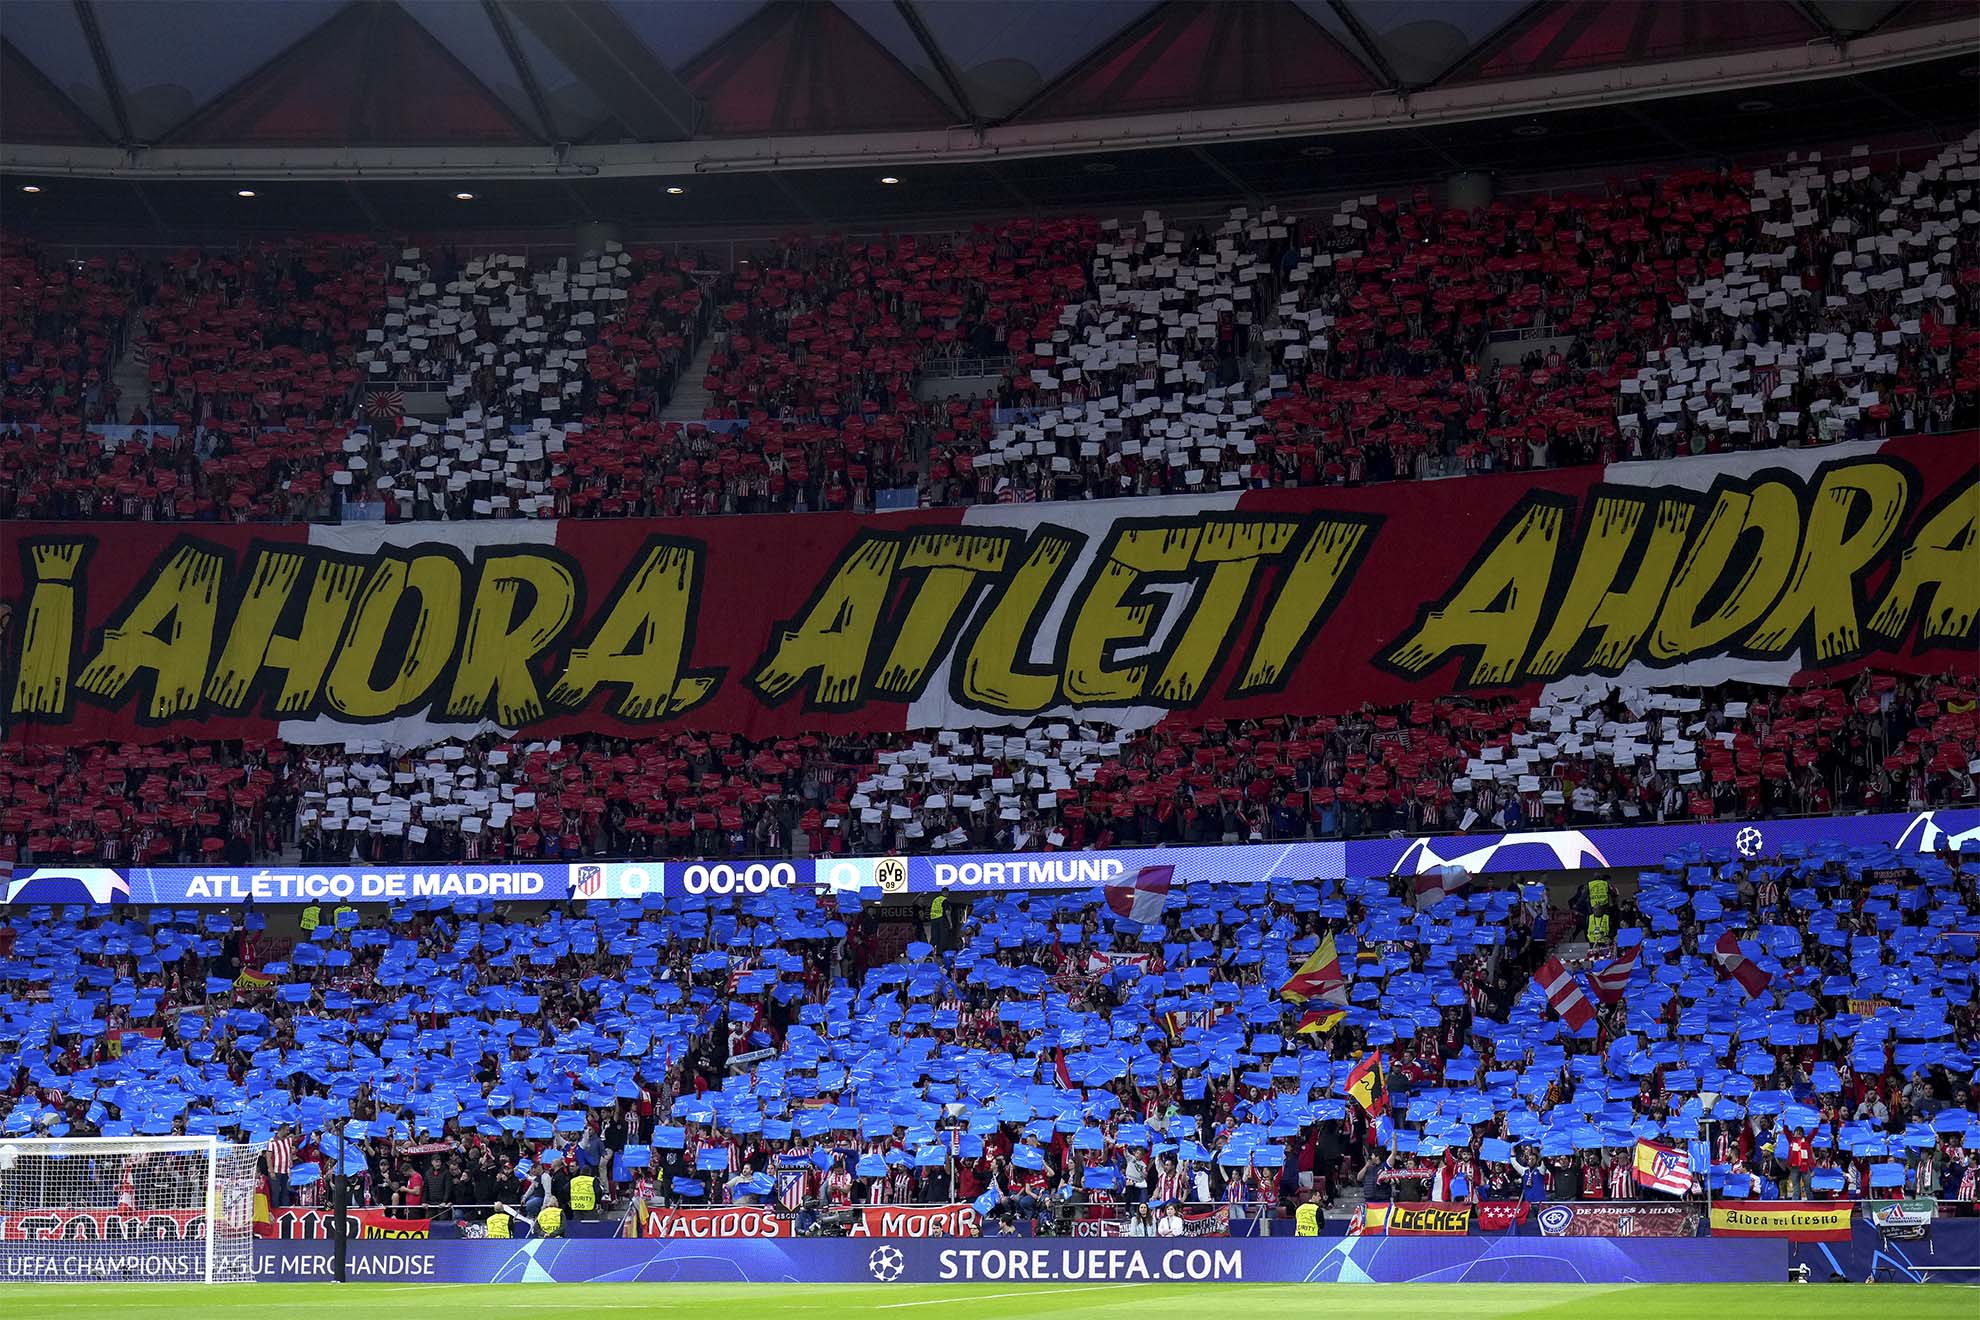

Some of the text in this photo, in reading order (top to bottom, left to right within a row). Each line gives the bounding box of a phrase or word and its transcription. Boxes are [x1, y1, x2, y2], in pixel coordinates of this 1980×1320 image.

[752, 518, 1372, 712] ATLETI
[185, 870, 545, 898] ATLÉTICO DE MADRID
[618, 866, 651, 896] 0
[683, 862, 797, 895] 00:00
[879, 862, 903, 882] BVB
[885, 881, 896, 889] 09
[935, 859, 1124, 887] DORTMUND
[648, 1210, 779, 1238] NACIDOS
[1391, 1207, 1469, 1231] LOECHES
[1726, 1210, 1768, 1225] Aldea
[8, 1256, 58, 1275] UEFA
[63, 1255, 189, 1275] CHAMPIONS
[195, 1255, 275, 1275] LAGUE
[939, 1249, 1243, 1279] STORE.UEFA.COM
